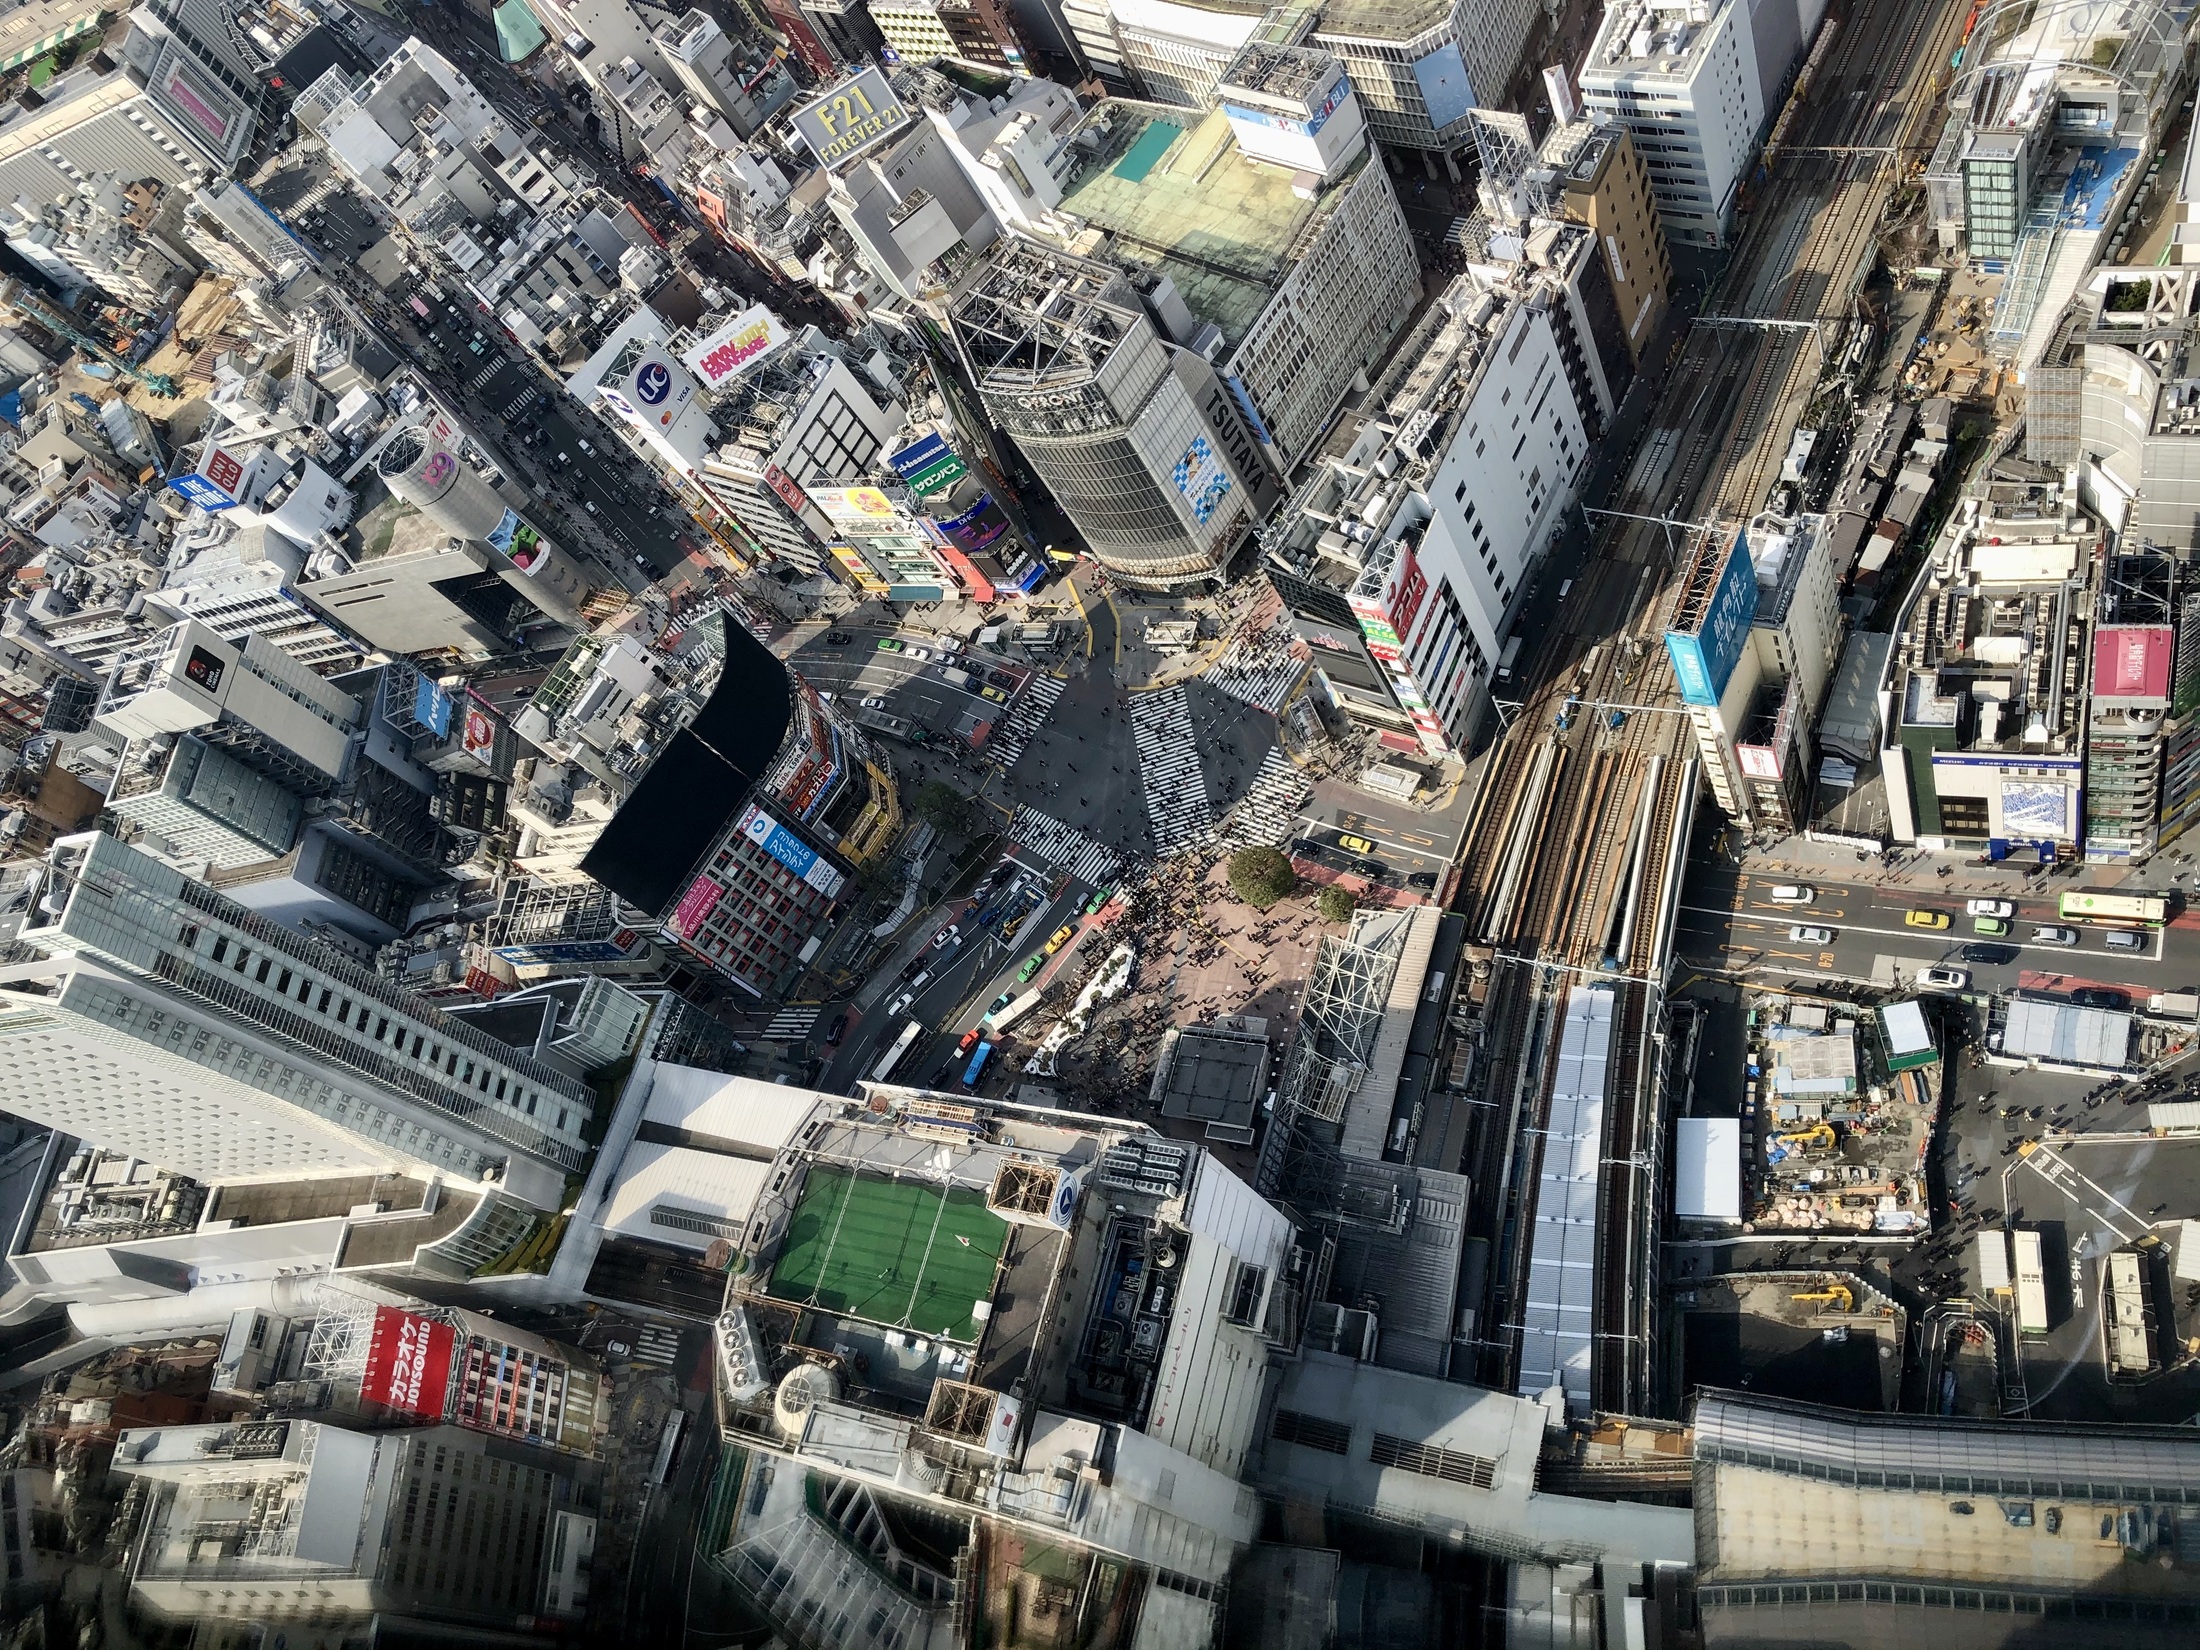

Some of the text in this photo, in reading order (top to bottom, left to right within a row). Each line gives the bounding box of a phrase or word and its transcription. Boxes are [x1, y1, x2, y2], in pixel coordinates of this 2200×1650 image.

[815, 85, 874, 137] F21
[1314, 85, 1346, 128] SEIBU
[819, 104, 902, 162] FOREVER 21
[700, 340, 740, 373] HMV
[638, 364, 668, 401] UC
[677, 386, 690, 402] VISA
[1206, 388, 1265, 494] TSUTAYA
[211, 456, 228, 480] UNI
[222, 464, 238, 488] QLO
[420, 452, 456, 486] 109
[914, 462, 960, 492] サロンパス
[180, 480, 208, 494] THE
[958, 512, 976, 526] DHC
[1006, 550, 1028, 576] DMM
[1394, 571, 1421, 628] アコム
[1714, 572, 1740, 640] 龍角散
[1362, 620, 1392, 632] レイク
[1366, 628, 1397, 640] ALSA
[1716, 582, 1746, 657] ダイレクト
[206, 670, 215, 686] TOHO
[794, 807, 802, 816] 7F
[808, 774, 825, 798] ガスト
[769, 838, 804, 868] アイシティ
[777, 830, 811, 860] コンタクトの
[688, 889, 720, 932] 品川美容外科
[1818, 952, 1834, 968] 8-20
[658, 1030, 673, 1059] MARK
[389, 1316, 417, 1403] カラオケ
[407, 1321, 430, 1407] JOYSOUND
[460, 1348, 473, 1410] カラオケ JOYSOUND
